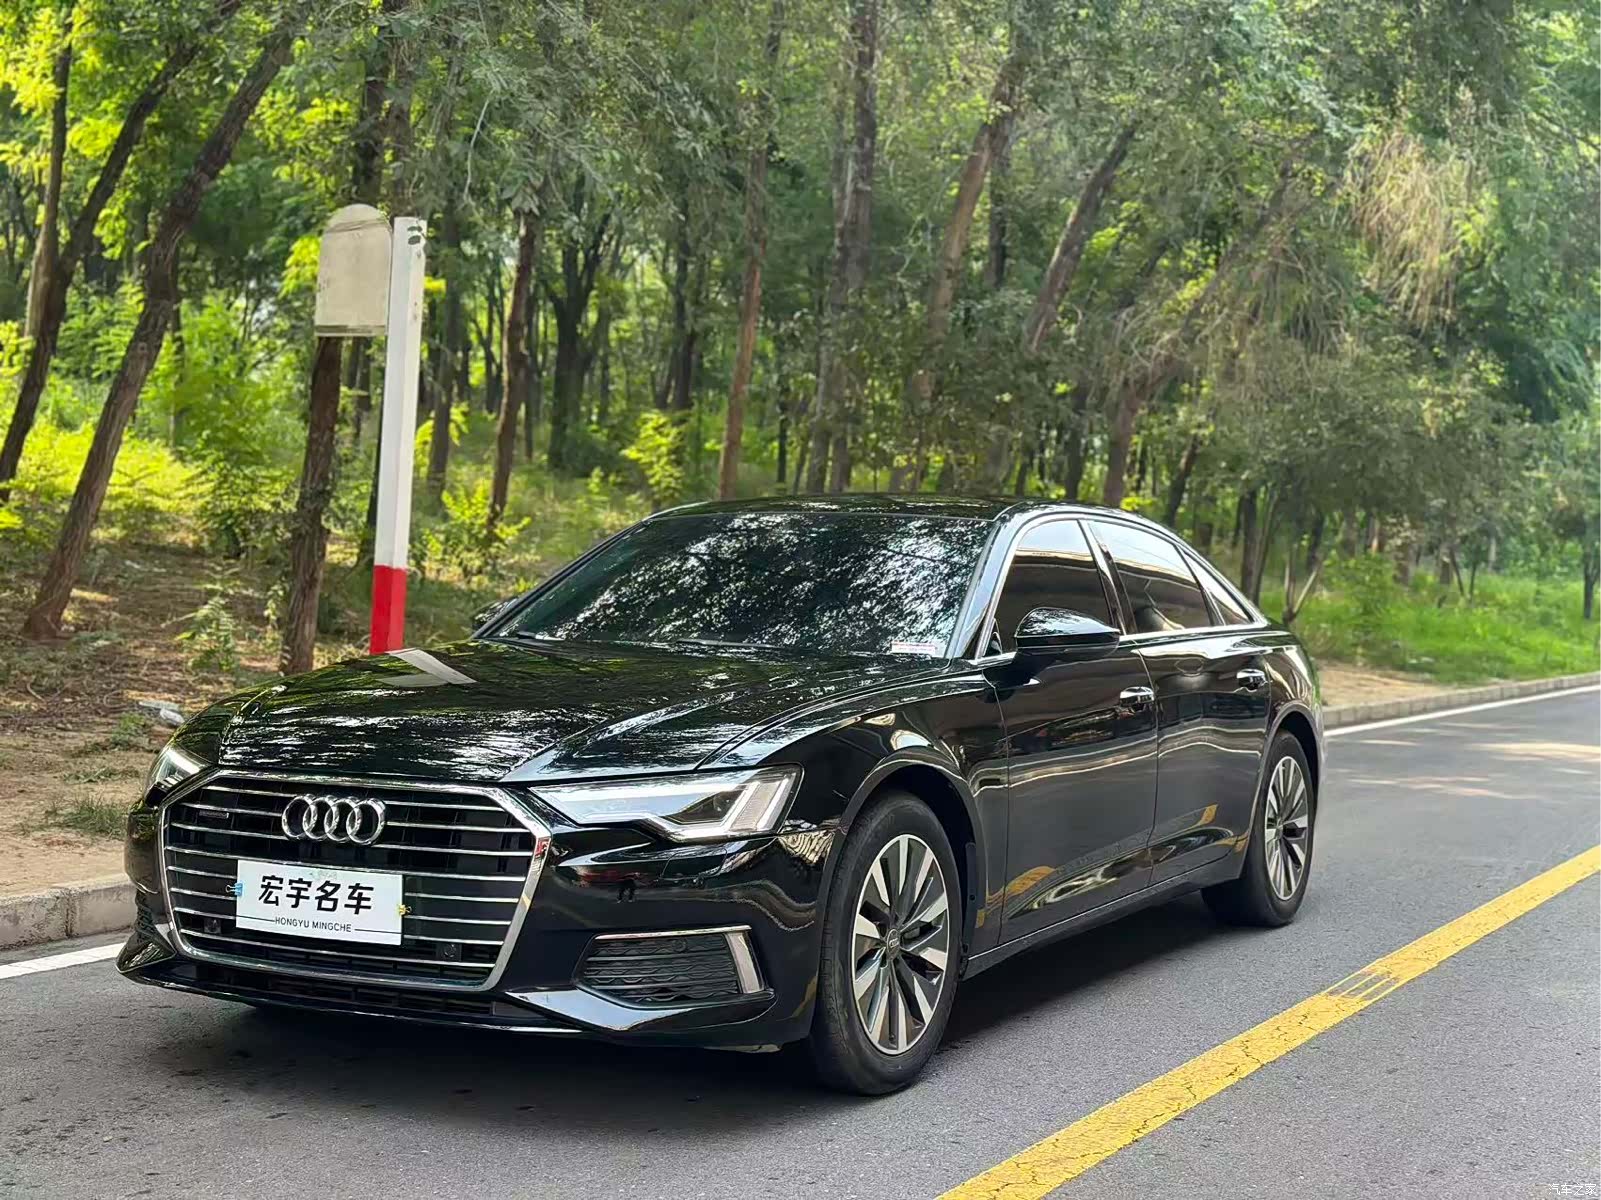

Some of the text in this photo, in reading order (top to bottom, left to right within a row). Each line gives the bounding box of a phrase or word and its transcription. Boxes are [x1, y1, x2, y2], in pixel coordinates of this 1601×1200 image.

[258, 875, 374, 915] 宏宇名车
[275, 916, 352, 933] HONGYU MINGCHE
